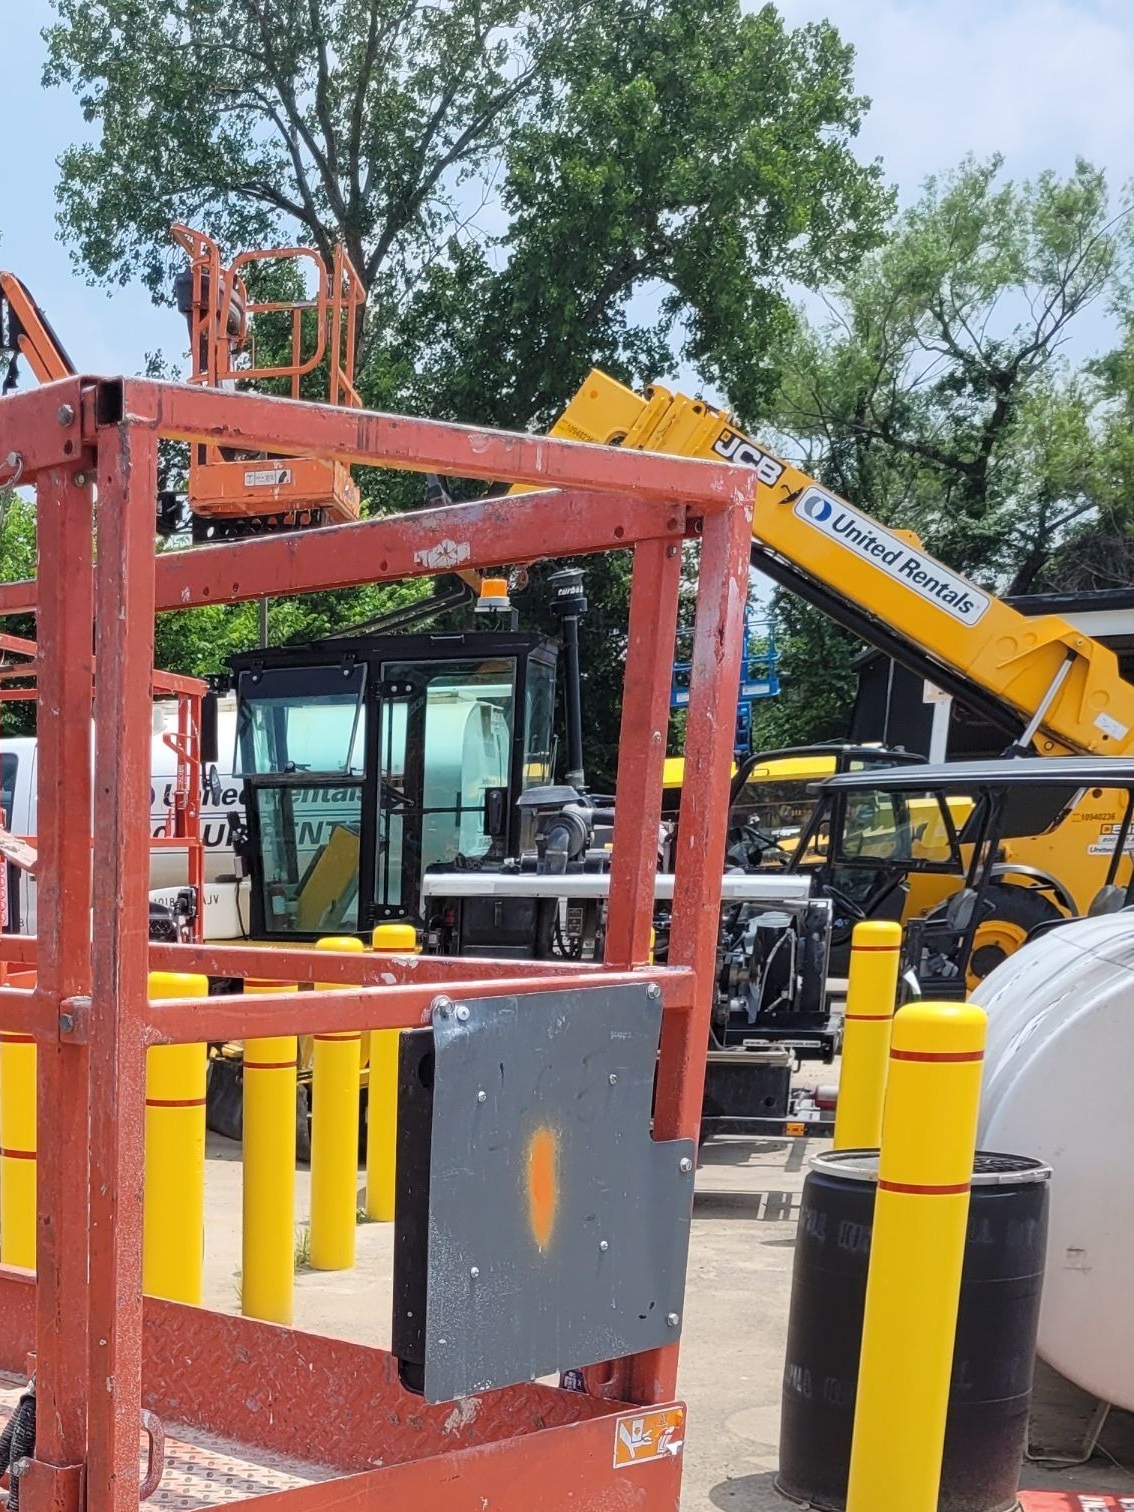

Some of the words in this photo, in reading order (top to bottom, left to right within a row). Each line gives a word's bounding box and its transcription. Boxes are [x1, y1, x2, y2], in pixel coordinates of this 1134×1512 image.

[714, 435, 785, 488] JCB
[831, 512, 904, 567] United
[897, 555, 977, 615] Rentals
